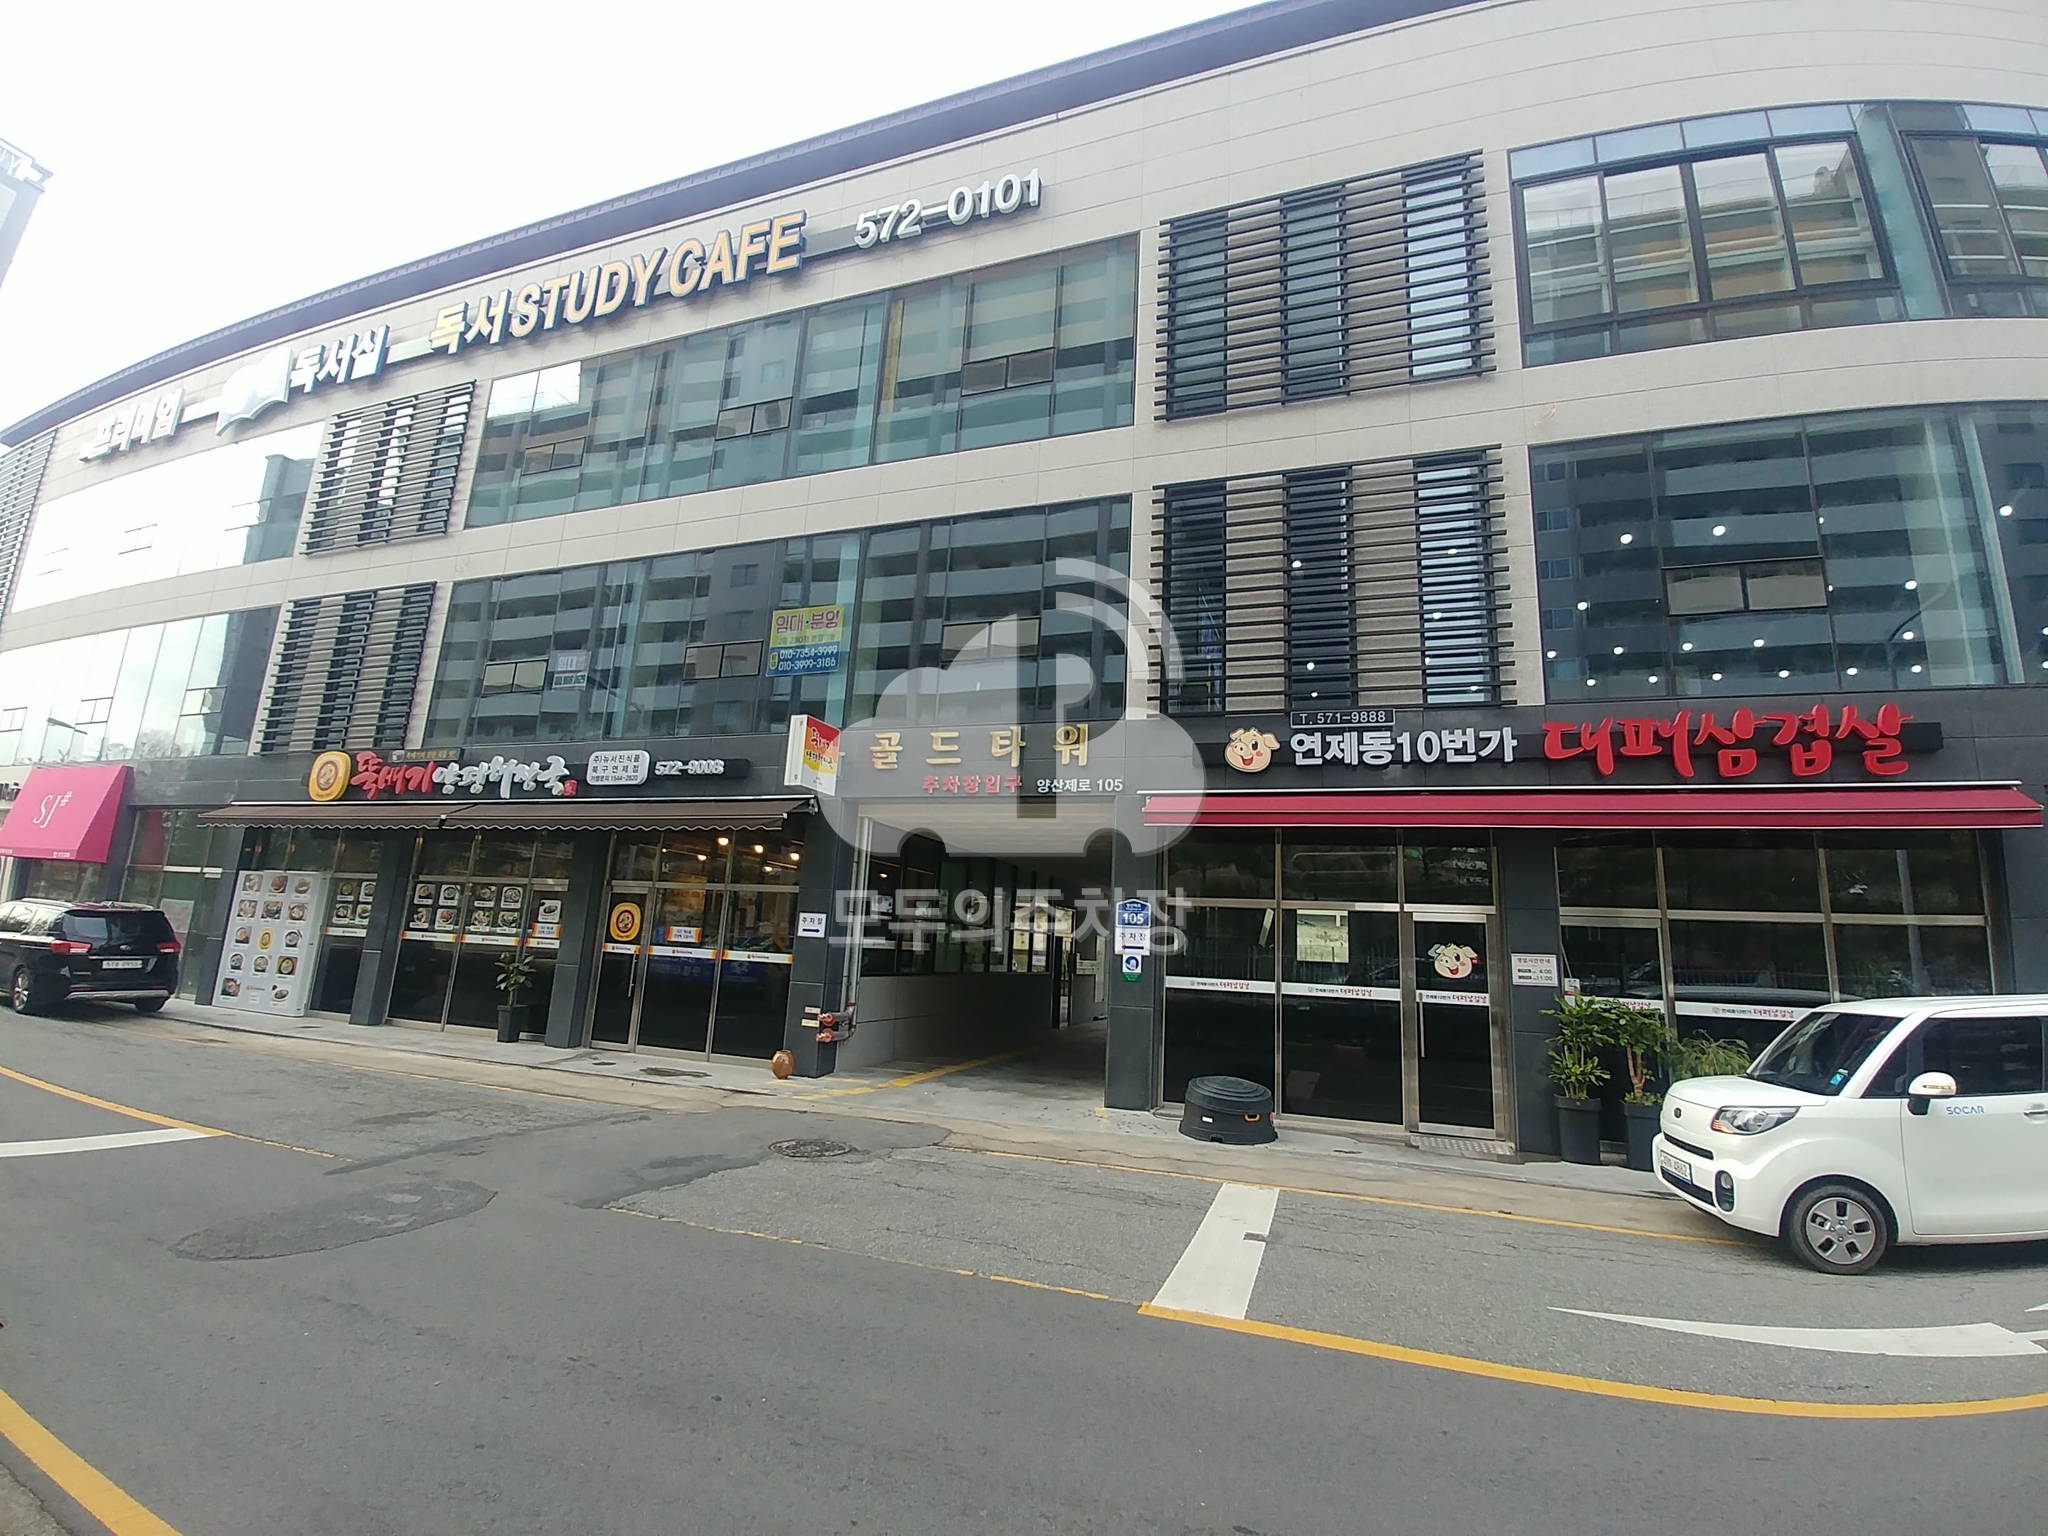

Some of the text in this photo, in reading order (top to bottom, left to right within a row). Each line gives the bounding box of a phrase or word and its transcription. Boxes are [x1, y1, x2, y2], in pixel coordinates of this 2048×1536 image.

[853, 167, 1042, 250] 572-0101
[289, 323, 391, 393] 독서실
[79, 387, 184, 462] 프리미엄
[780, 645, 837, 659] 010-7354-3999
[778, 657, 836, 671] 010-3999-3186
[869, 723, 1089, 770] 골드타워
[1290, 726, 1518, 765] 연제동10번가
[1542, 703, 1913, 778] 대패삼겹살
[922, 774, 1023, 794] 주차장입구
[1036, 778, 1123, 793] 양산제로 105
[802, 916, 824, 925] 주차장
[1122, 913, 1144, 924] 105
[1119, 932, 1147, 941] 주차장
[1946, 1105, 1985, 1115] SOCAR
